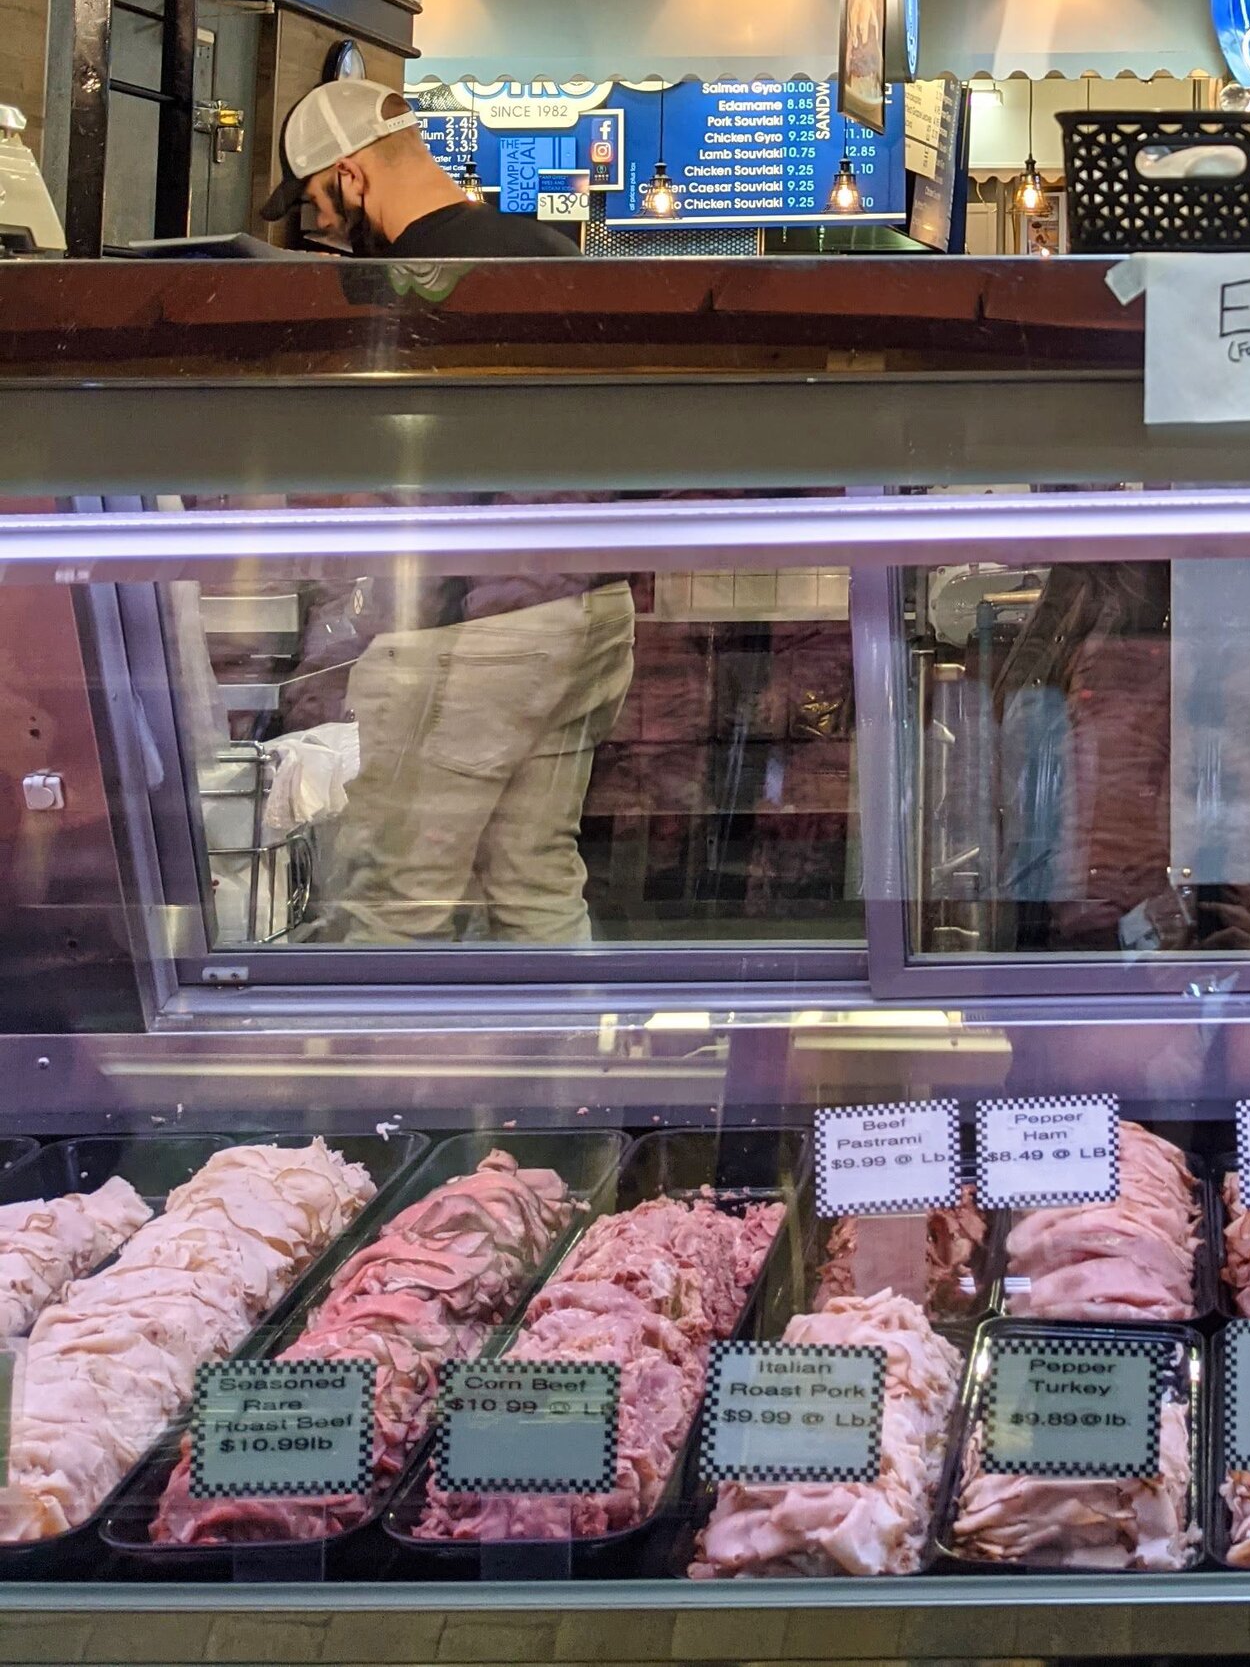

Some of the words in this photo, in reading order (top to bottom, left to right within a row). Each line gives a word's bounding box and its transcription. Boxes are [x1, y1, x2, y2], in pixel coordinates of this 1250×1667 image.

[702, 82, 749, 94] Salmon
[751, 82, 782, 96] Gyro
[783, 82, 814, 93] 10.00
[490, 106, 531, 118] SINCE
[537, 105, 568, 117] 1982
[786, 98, 814, 110] 8.85
[446, 117, 478, 129] 2.45
[707, 115, 733, 127] Pork
[734, 114, 783, 127] Souvlaki
[787, 114, 815, 125] 9.25
[446, 129, 478, 140] 2.70
[704, 131, 752, 143] Chicken
[754, 131, 783, 145] Gyro
[788, 130, 816, 141] 9.25
[446, 140, 478, 152] 3.35
[501, 139, 520, 149] THE
[699, 148, 732, 160] Lamb
[734, 148, 783, 159] Souvlaki
[783, 147, 816, 158] 10.75
[520, 137, 536, 212] SPECIAL
[683, 164, 732, 177] Chicken
[734, 163, 783, 176] Souvlaki
[786, 164, 815, 176] 9.25
[507, 149, 520, 212] OLYMPIA
[688, 181, 732, 193] Caesar
[734, 181, 783, 193] Souvlaki
[787, 181, 815, 192] 9.25
[684, 197, 732, 209] Chicken
[734, 197, 783, 209] Souvlaki
[787, 197, 815, 208] 9.25
[862, 1117, 907, 1132] Beef
[1014, 1111, 1083, 1126] Pepper
[836, 1133, 923, 1151] Pastrami
[1023, 1129, 1068, 1142] Ham
[830, 1156, 887, 1170] $9.99
[894, 1154, 913, 1165] @
[986, 1149, 1044, 1163] $8.49
[1052, 1148, 1071, 1160] @
[759, 1360, 833, 1375] Italian
[1028, 1358, 1117, 1376] Pepper
[218, 1375, 347, 1392] Seasoned
[463, 1375, 522, 1391] Corn
[531, 1377, 587, 1392] Beef
[729, 1382, 802, 1397] Roast
[810, 1384, 866, 1398] Pork
[1030, 1379, 1112, 1396] Turkey
[243, 1399, 304, 1412] Rare
[214, 1418, 288, 1433] Roast
[296, 1413, 354, 1431] Beef
[722, 1408, 792, 1425] $9.99
[801, 1412, 825, 1425] @
